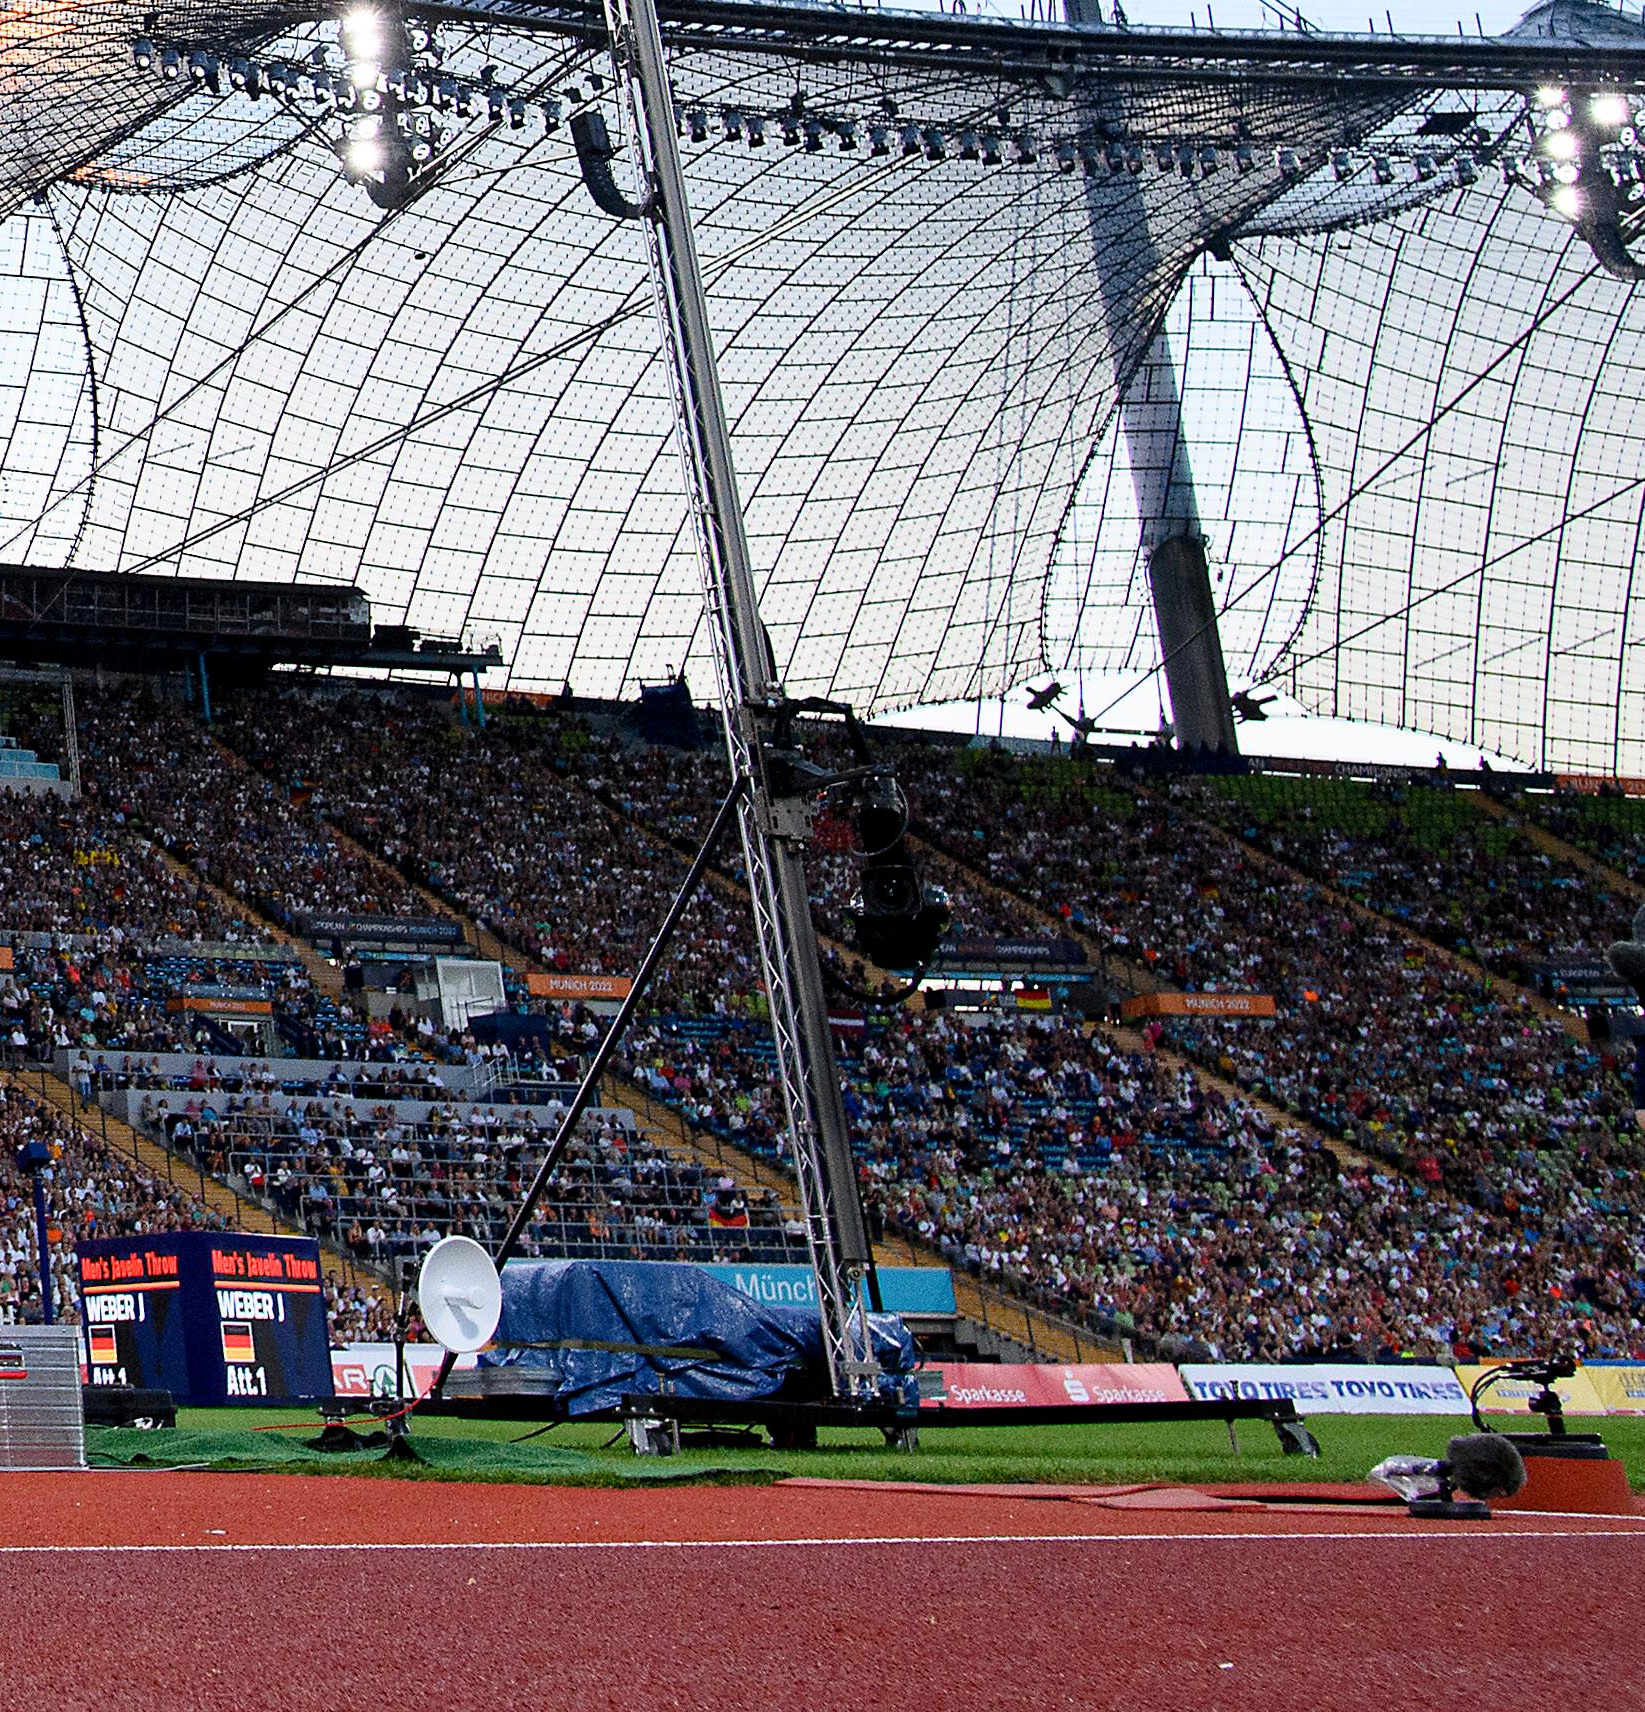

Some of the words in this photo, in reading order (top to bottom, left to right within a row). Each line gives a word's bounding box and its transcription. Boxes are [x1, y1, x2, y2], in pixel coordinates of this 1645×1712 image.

[549, 978, 587, 991] MUNICH
[589, 980, 613, 992] 2022
[81, 1256, 109, 1281] Men's
[110, 1254, 144, 1279] Javelin
[144, 1251, 178, 1277] Throw
[211, 1249, 244, 1277] Men's
[246, 1251, 283, 1278] Javelin
[283, 1253, 317, 1280] Throw
[85, 1294, 136, 1322] WEBER
[138, 1292, 146, 1322] J
[216, 1290, 275, 1320] WEBER
[277, 1292, 285, 1322] J
[950, 1384, 1028, 1405] Sparkasse
[1092, 1385, 1166, 1403] Sparkasse
[1259, 1380, 1329, 1400] TIRES
[1330, 1379, 1396, 1399] TOYO
